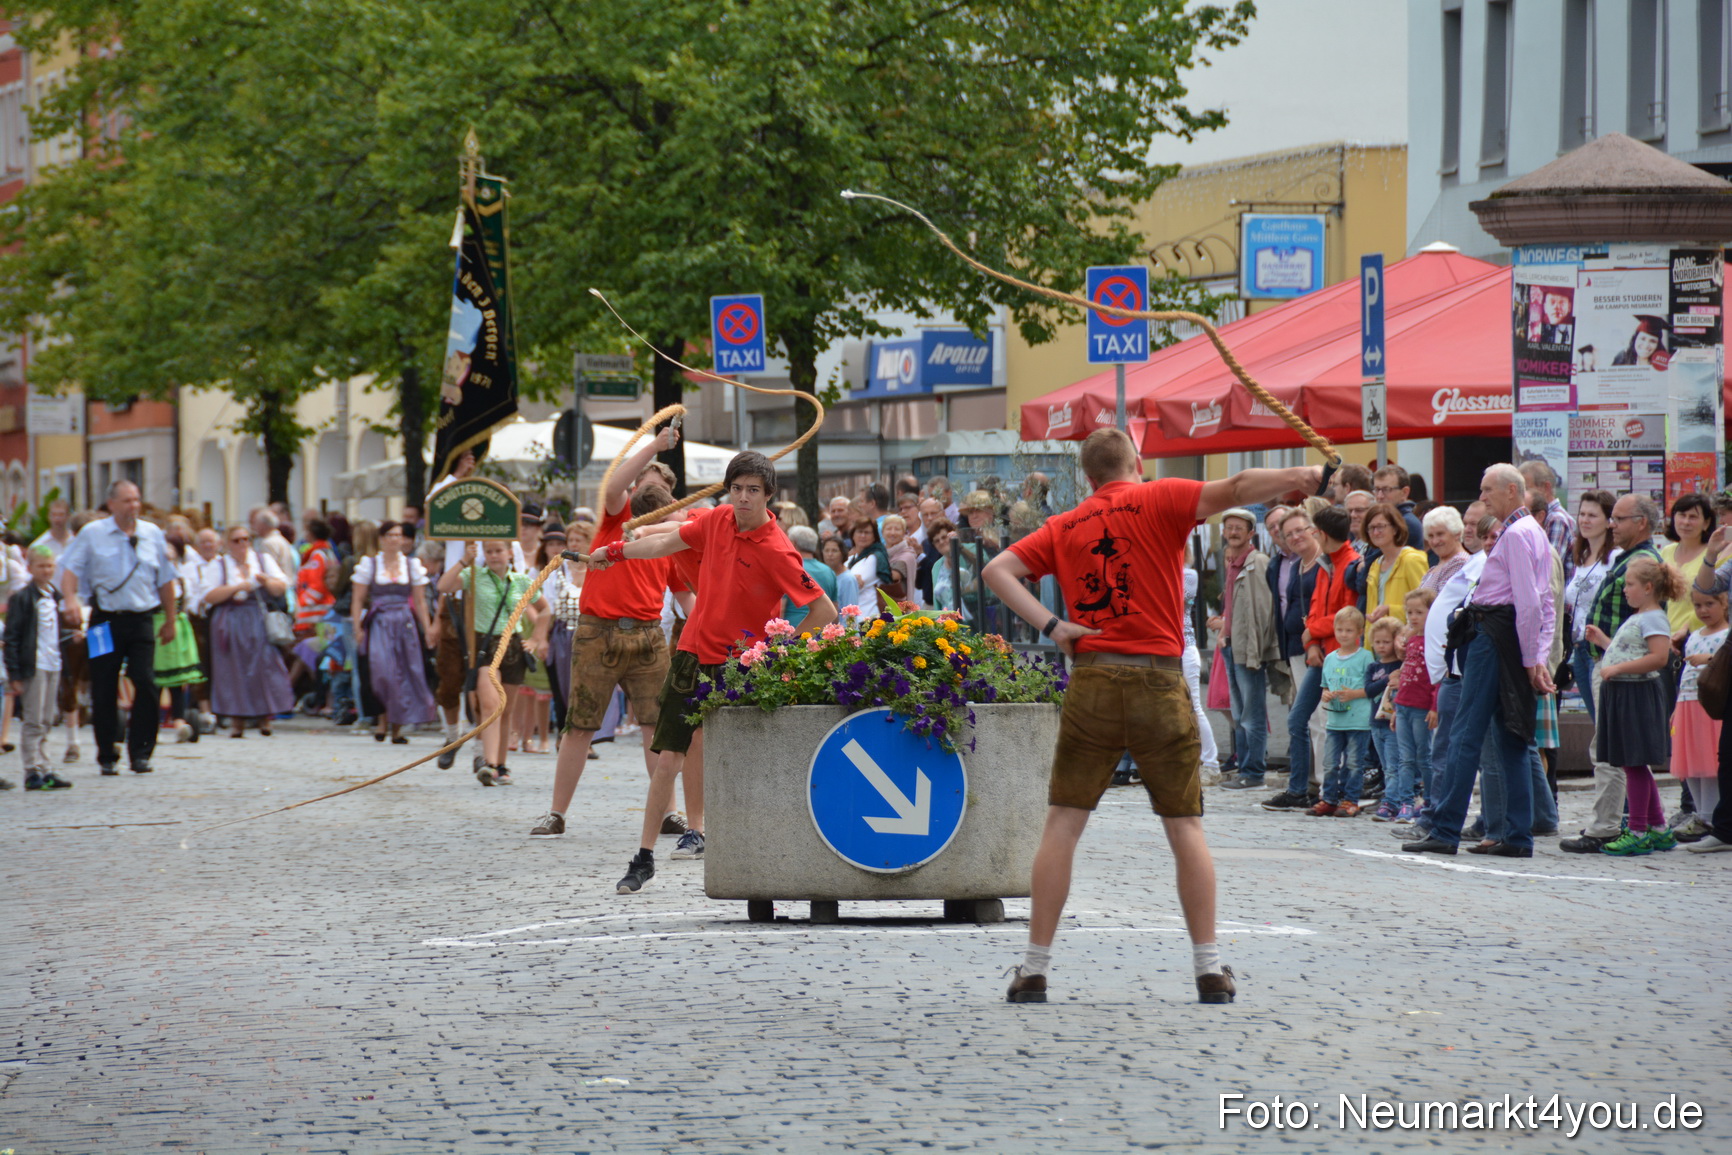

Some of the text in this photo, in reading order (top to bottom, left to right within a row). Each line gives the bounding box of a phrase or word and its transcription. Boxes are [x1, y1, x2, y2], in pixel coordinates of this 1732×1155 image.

[1261, 219, 1308, 231] Gasthaus
[1673, 256, 1696, 270] ADAC
[1365, 267, 1380, 336] P
[1593, 294, 1663, 303] BESSER STUDIEREN
[1676, 316, 1714, 324] MSC BERCHING
[1094, 334, 1143, 355] TAXI
[1527, 342, 1571, 352] KARL VALENTIN
[718, 349, 760, 368] TAXI
[928, 343, 988, 365] APOLLO
[955, 364, 981, 374] OPTIK
[1517, 358, 1577, 376] KOMIKERS
[1569, 417, 1616, 428] SOMMER
[1569, 428, 1613, 438] IM PARK
[1569, 440, 1605, 449] EXTRA
[1607, 439, 1631, 449] 2017
[433, 523, 512, 534] HÖRMANNSDORF
